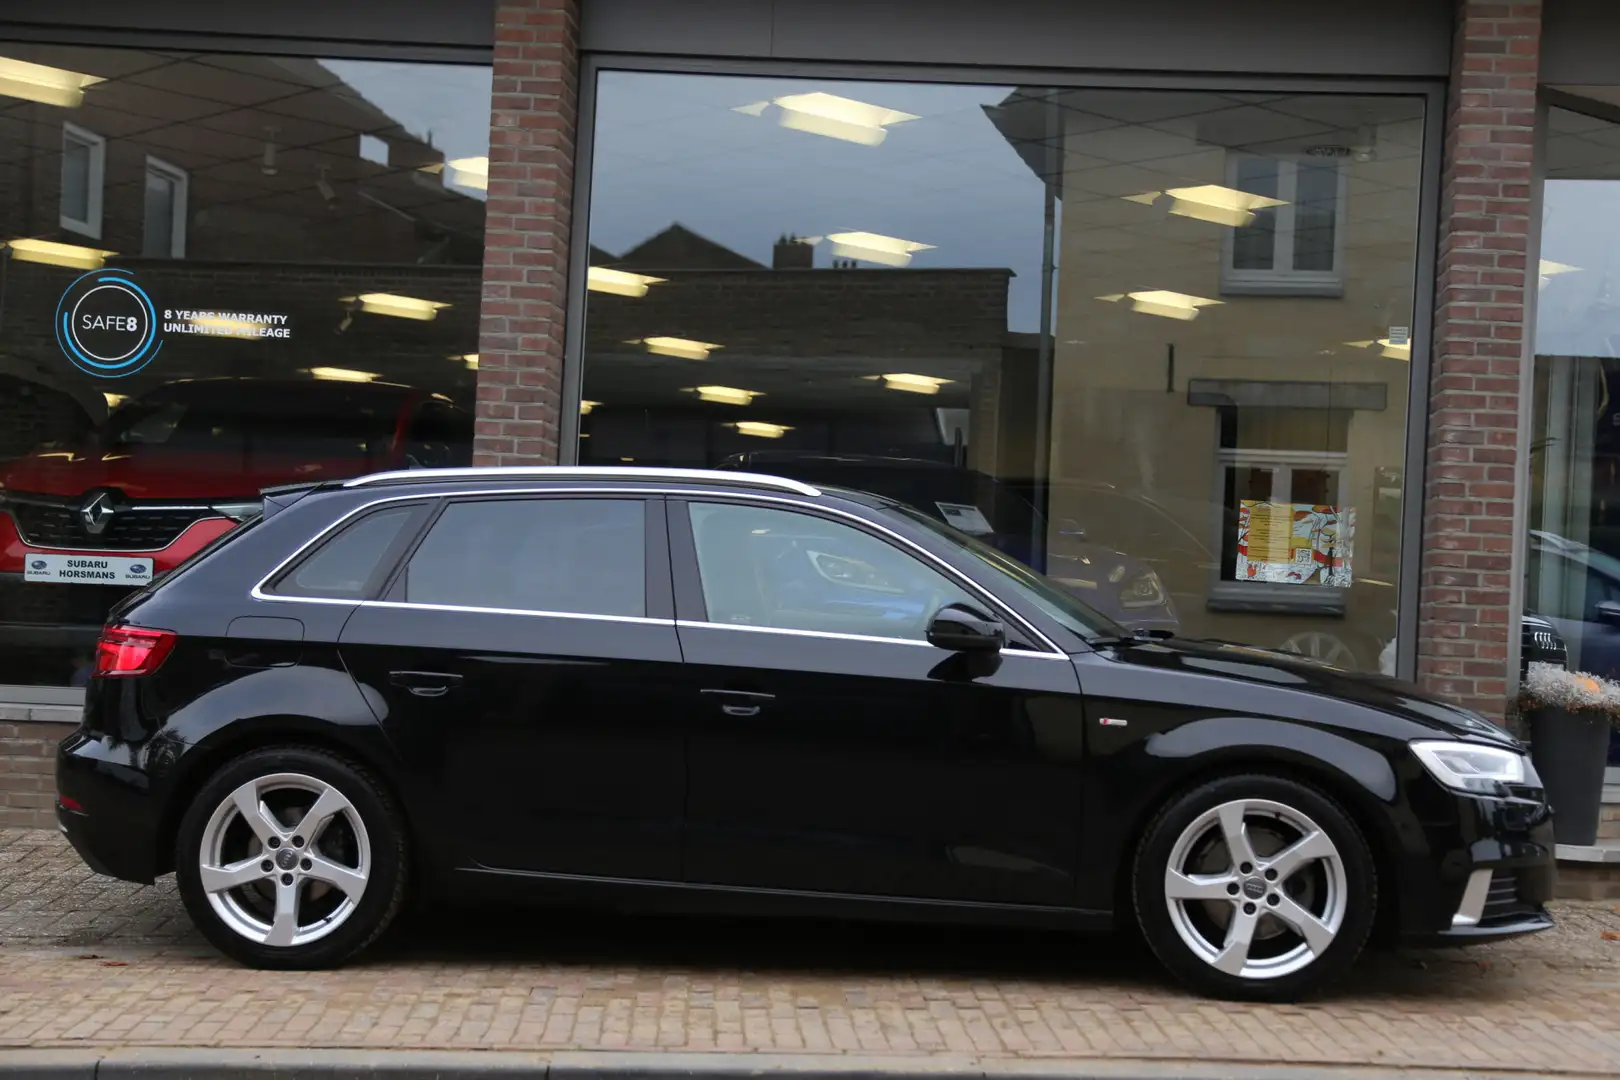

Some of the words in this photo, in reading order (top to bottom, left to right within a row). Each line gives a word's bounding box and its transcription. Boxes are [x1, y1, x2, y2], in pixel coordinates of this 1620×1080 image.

[82, 314, 138, 332] SAFE8
[164, 309, 172, 319] 8
[175, 310, 215, 321] YEARS
[218, 312, 288, 324] WARRANTY
[163, 322, 234, 336] UNLIMITED
[236, 326, 291, 338] MILEAGE
[67, 560, 108, 568] SUBARU
[59, 570, 115, 579] HORSMANS
